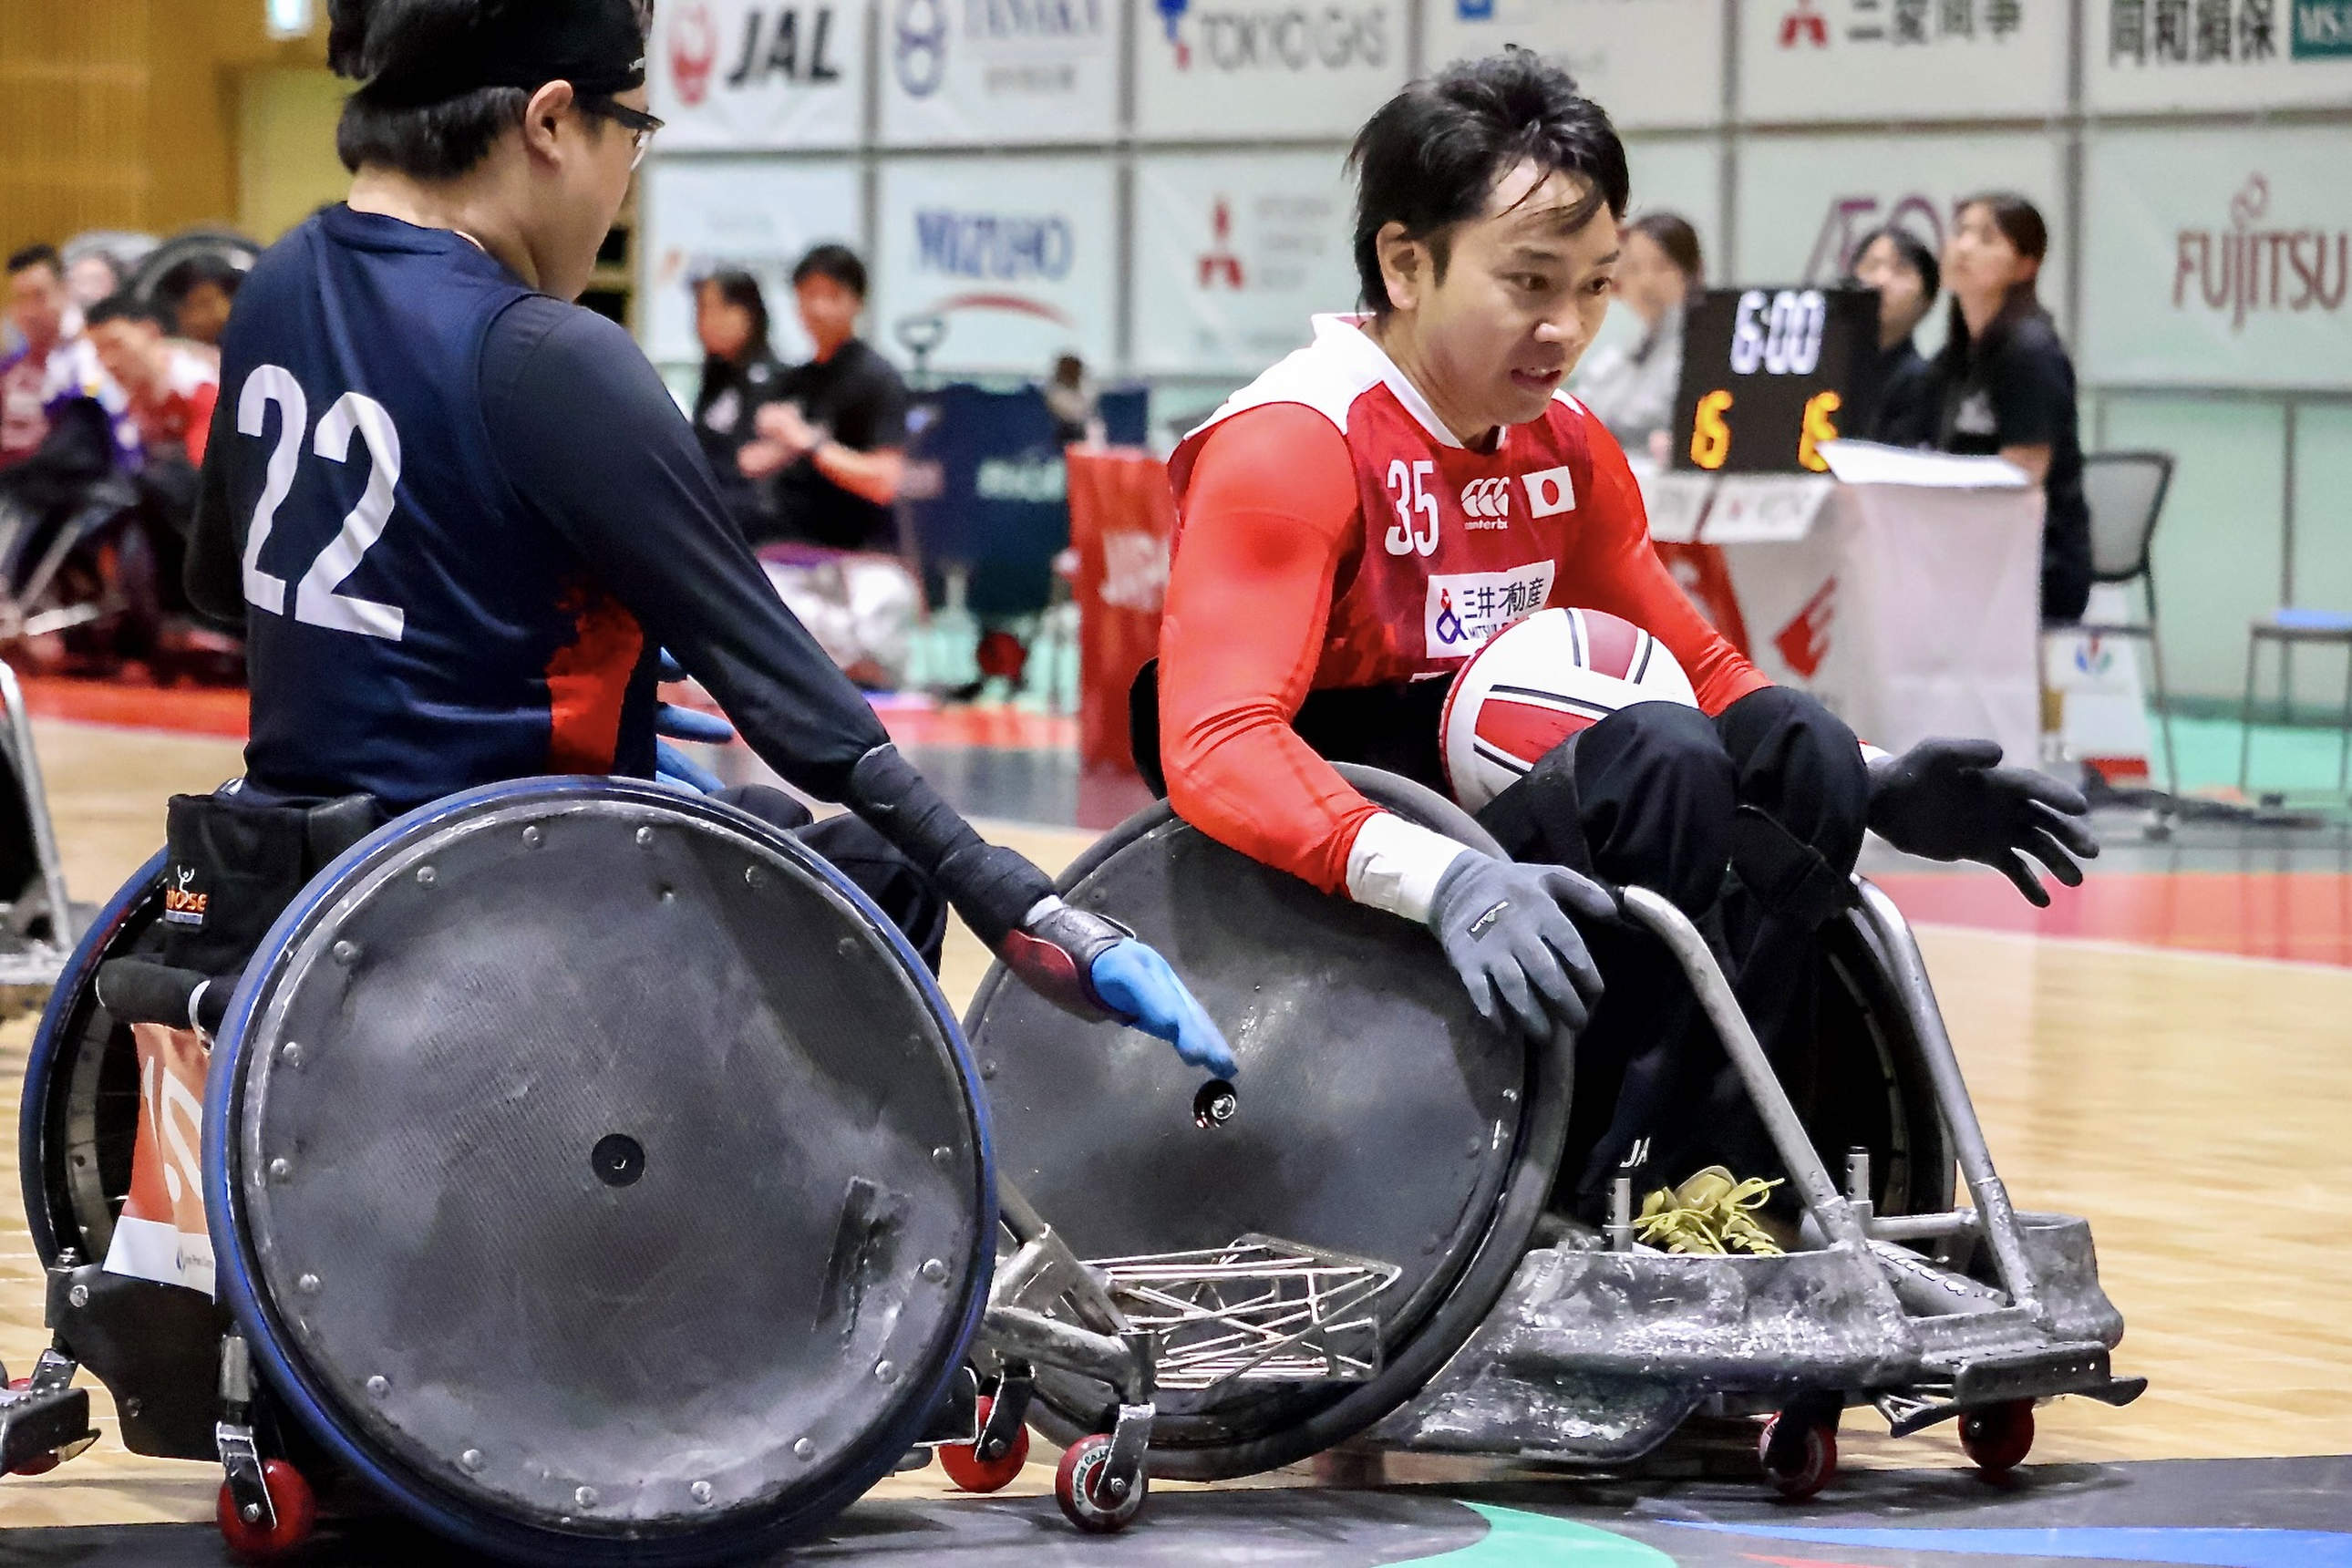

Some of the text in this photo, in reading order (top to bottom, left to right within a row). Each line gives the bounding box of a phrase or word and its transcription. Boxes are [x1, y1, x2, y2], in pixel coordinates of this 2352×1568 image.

[728, 6, 841, 87] JAL
[2171, 228, 2349, 334] FUJITSU
[1689, 389, 1734, 470] 6
[237, 365, 404, 641] 22
[1385, 459, 1439, 556] 35
[1462, 577, 1544, 619] 三井不動産
